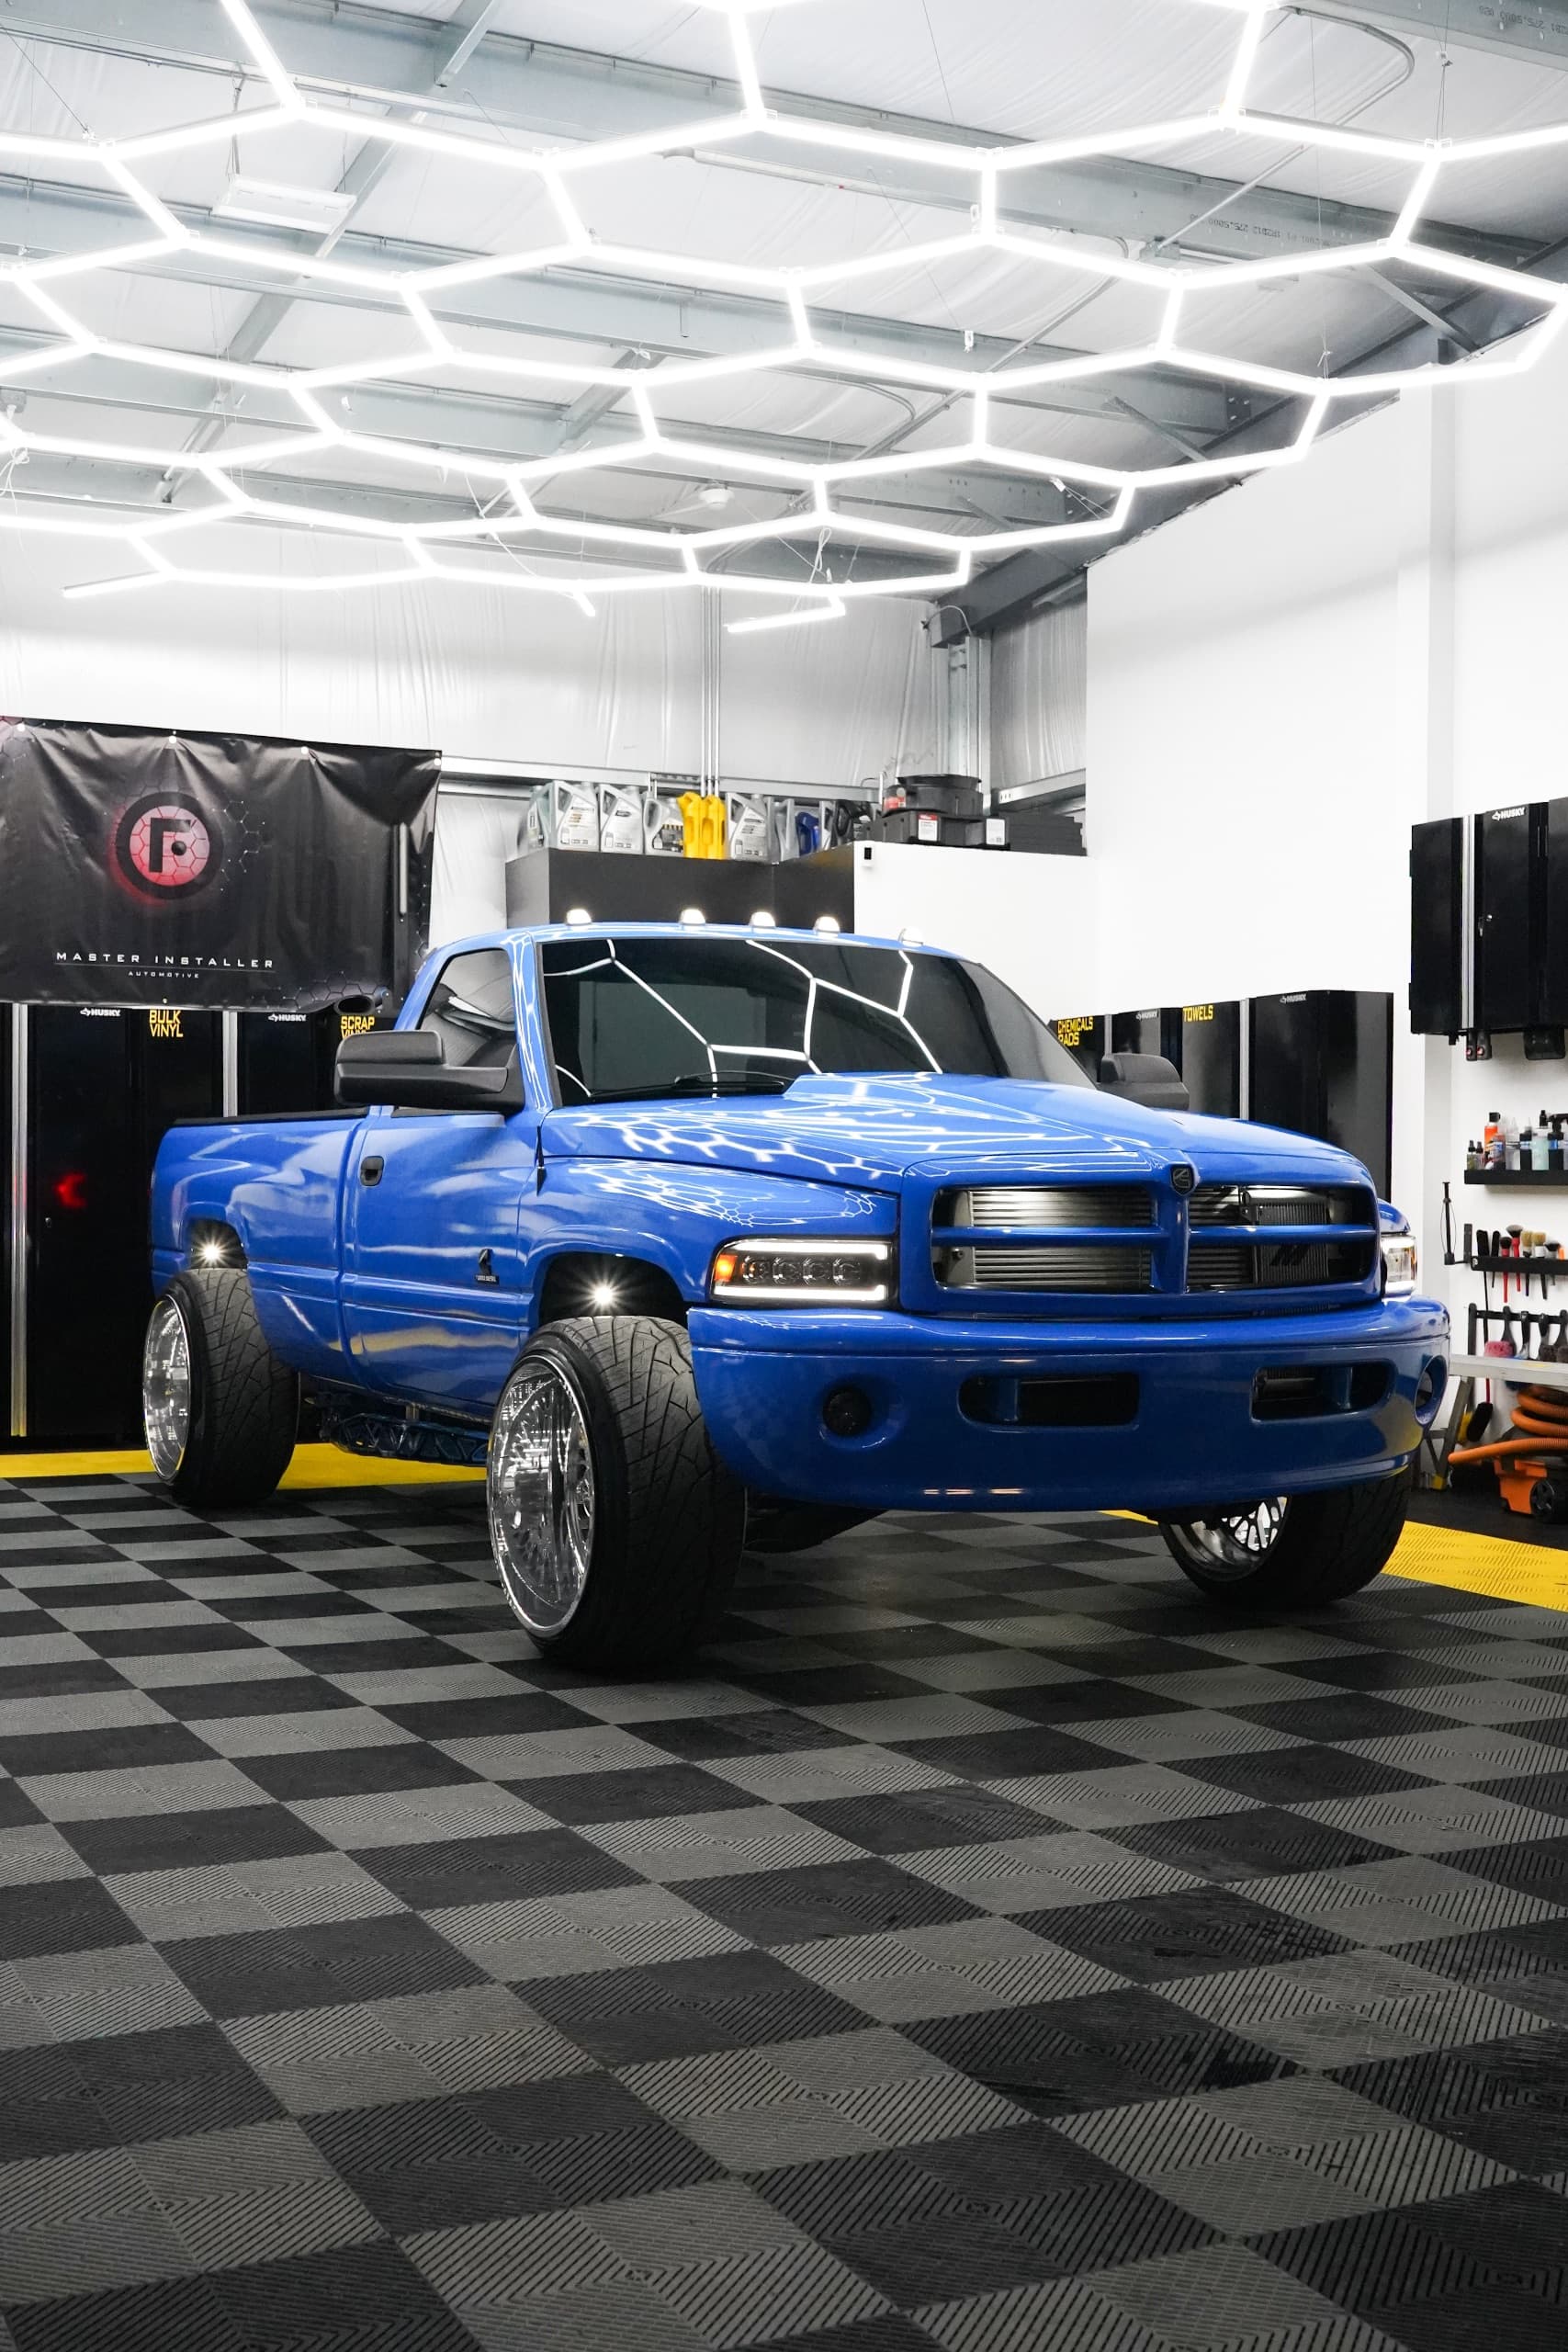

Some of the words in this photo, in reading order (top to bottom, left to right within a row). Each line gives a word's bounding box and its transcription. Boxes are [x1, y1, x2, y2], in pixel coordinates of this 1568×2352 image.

[1501, 807, 1525, 819] HUSKY
[56, 952, 140, 963] MASTER
[154, 956, 273, 968] INSTALLER
[91, 1009, 121, 1017] HUSKY
[149, 1009, 181, 1023] BULK
[1182, 1005, 1213, 1022] TOWELS
[341, 1015, 375, 1030] SCRAP
[1057, 1016, 1094, 1034] CHEMICALS
[150, 1023, 184, 1038] VINYL
